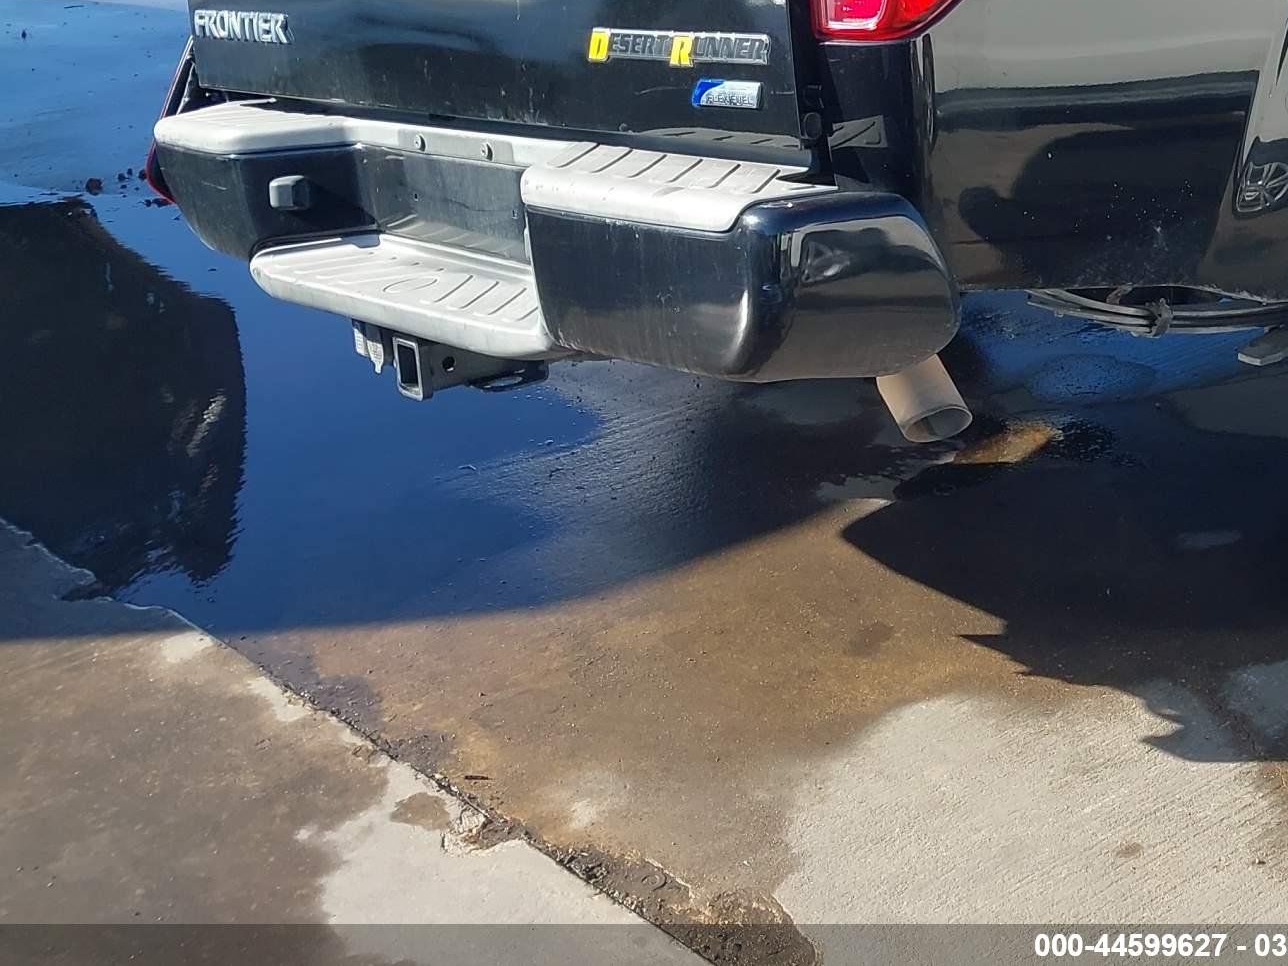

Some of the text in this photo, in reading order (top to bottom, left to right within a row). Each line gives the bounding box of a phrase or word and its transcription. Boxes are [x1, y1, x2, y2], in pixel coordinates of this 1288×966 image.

[194, 9, 288, 44] FRONTIER
[588, 30, 768, 66] DESERT RUNNER
